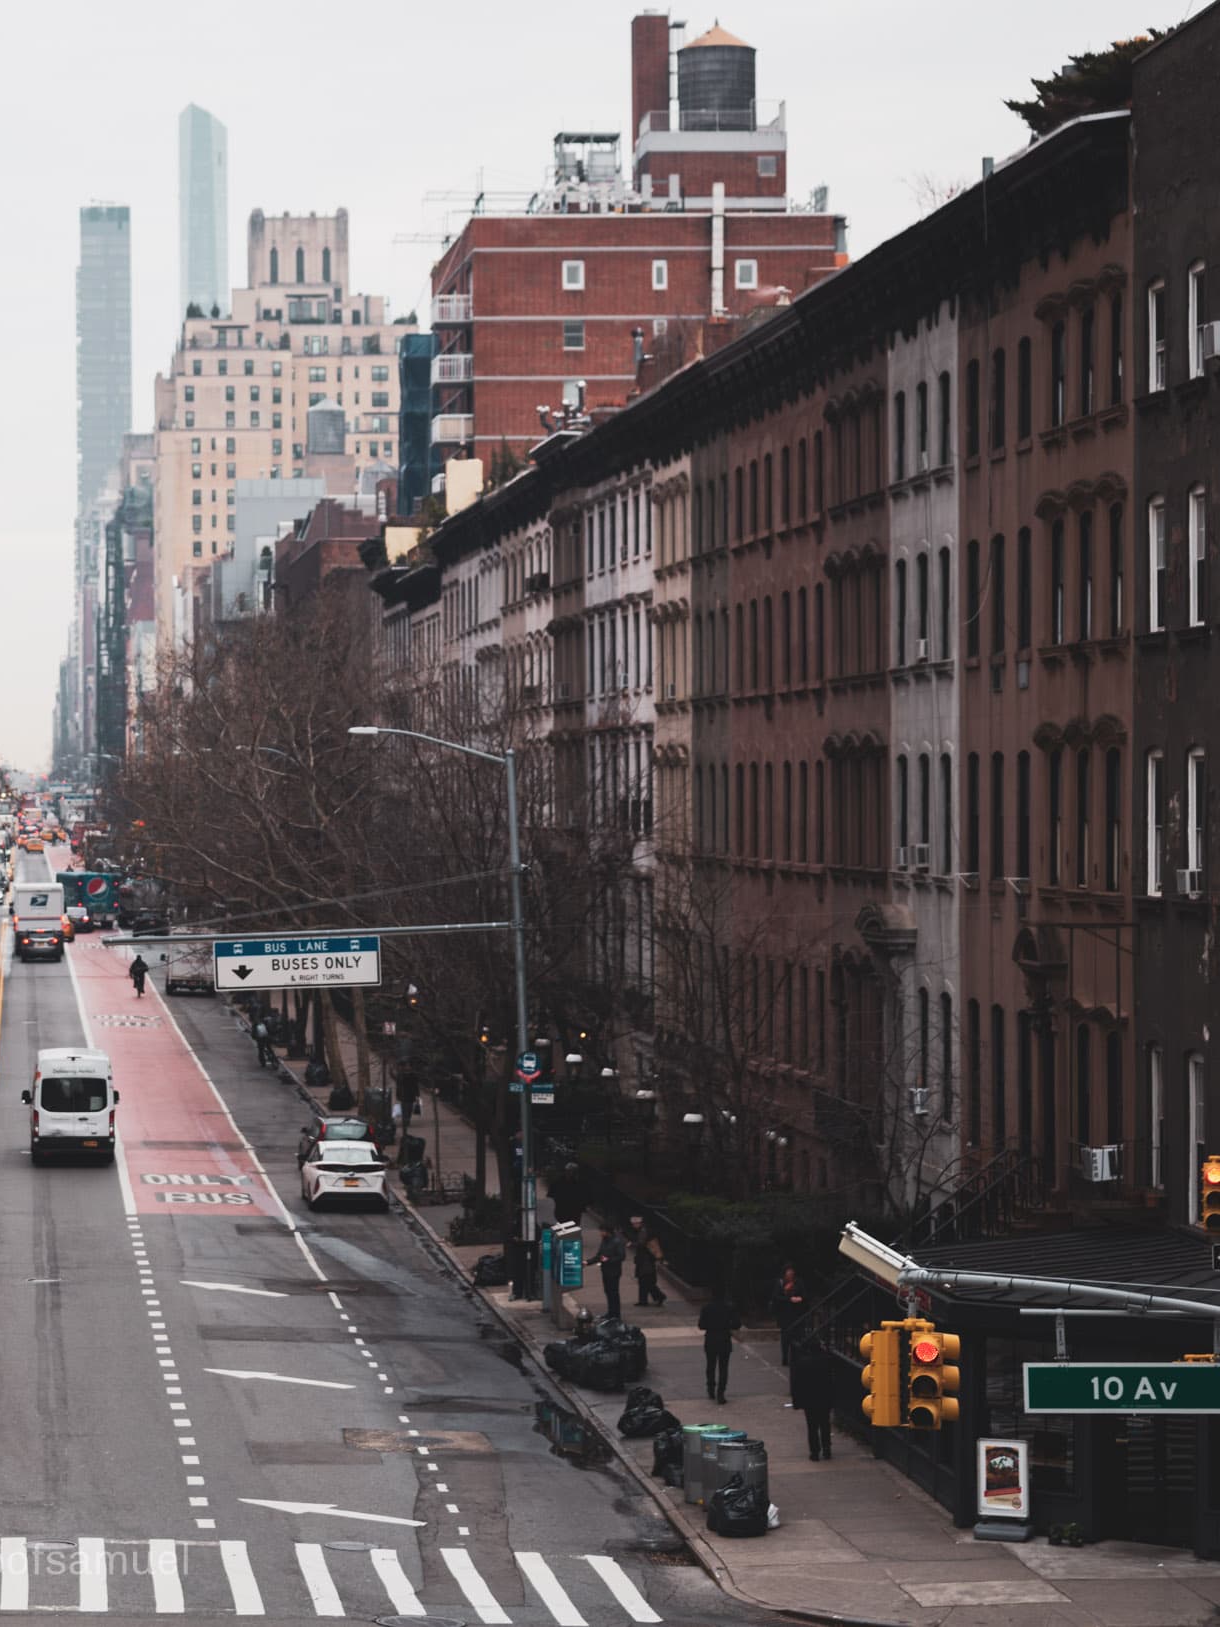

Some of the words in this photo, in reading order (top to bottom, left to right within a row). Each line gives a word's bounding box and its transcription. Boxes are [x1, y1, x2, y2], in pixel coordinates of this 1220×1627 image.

[264, 942, 287, 953] BUS
[298, 940, 329, 951] LANE
[271, 957, 319, 971] BUSES
[324, 956, 362, 969] ONLY
[322, 973, 345, 981] TURNS
[143, 1173, 248, 1186] ONLY
[164, 1192, 252, 1205] BUS
[1091, 1376, 1124, 1401] 10
[1133, 1376, 1178, 1401] Av
